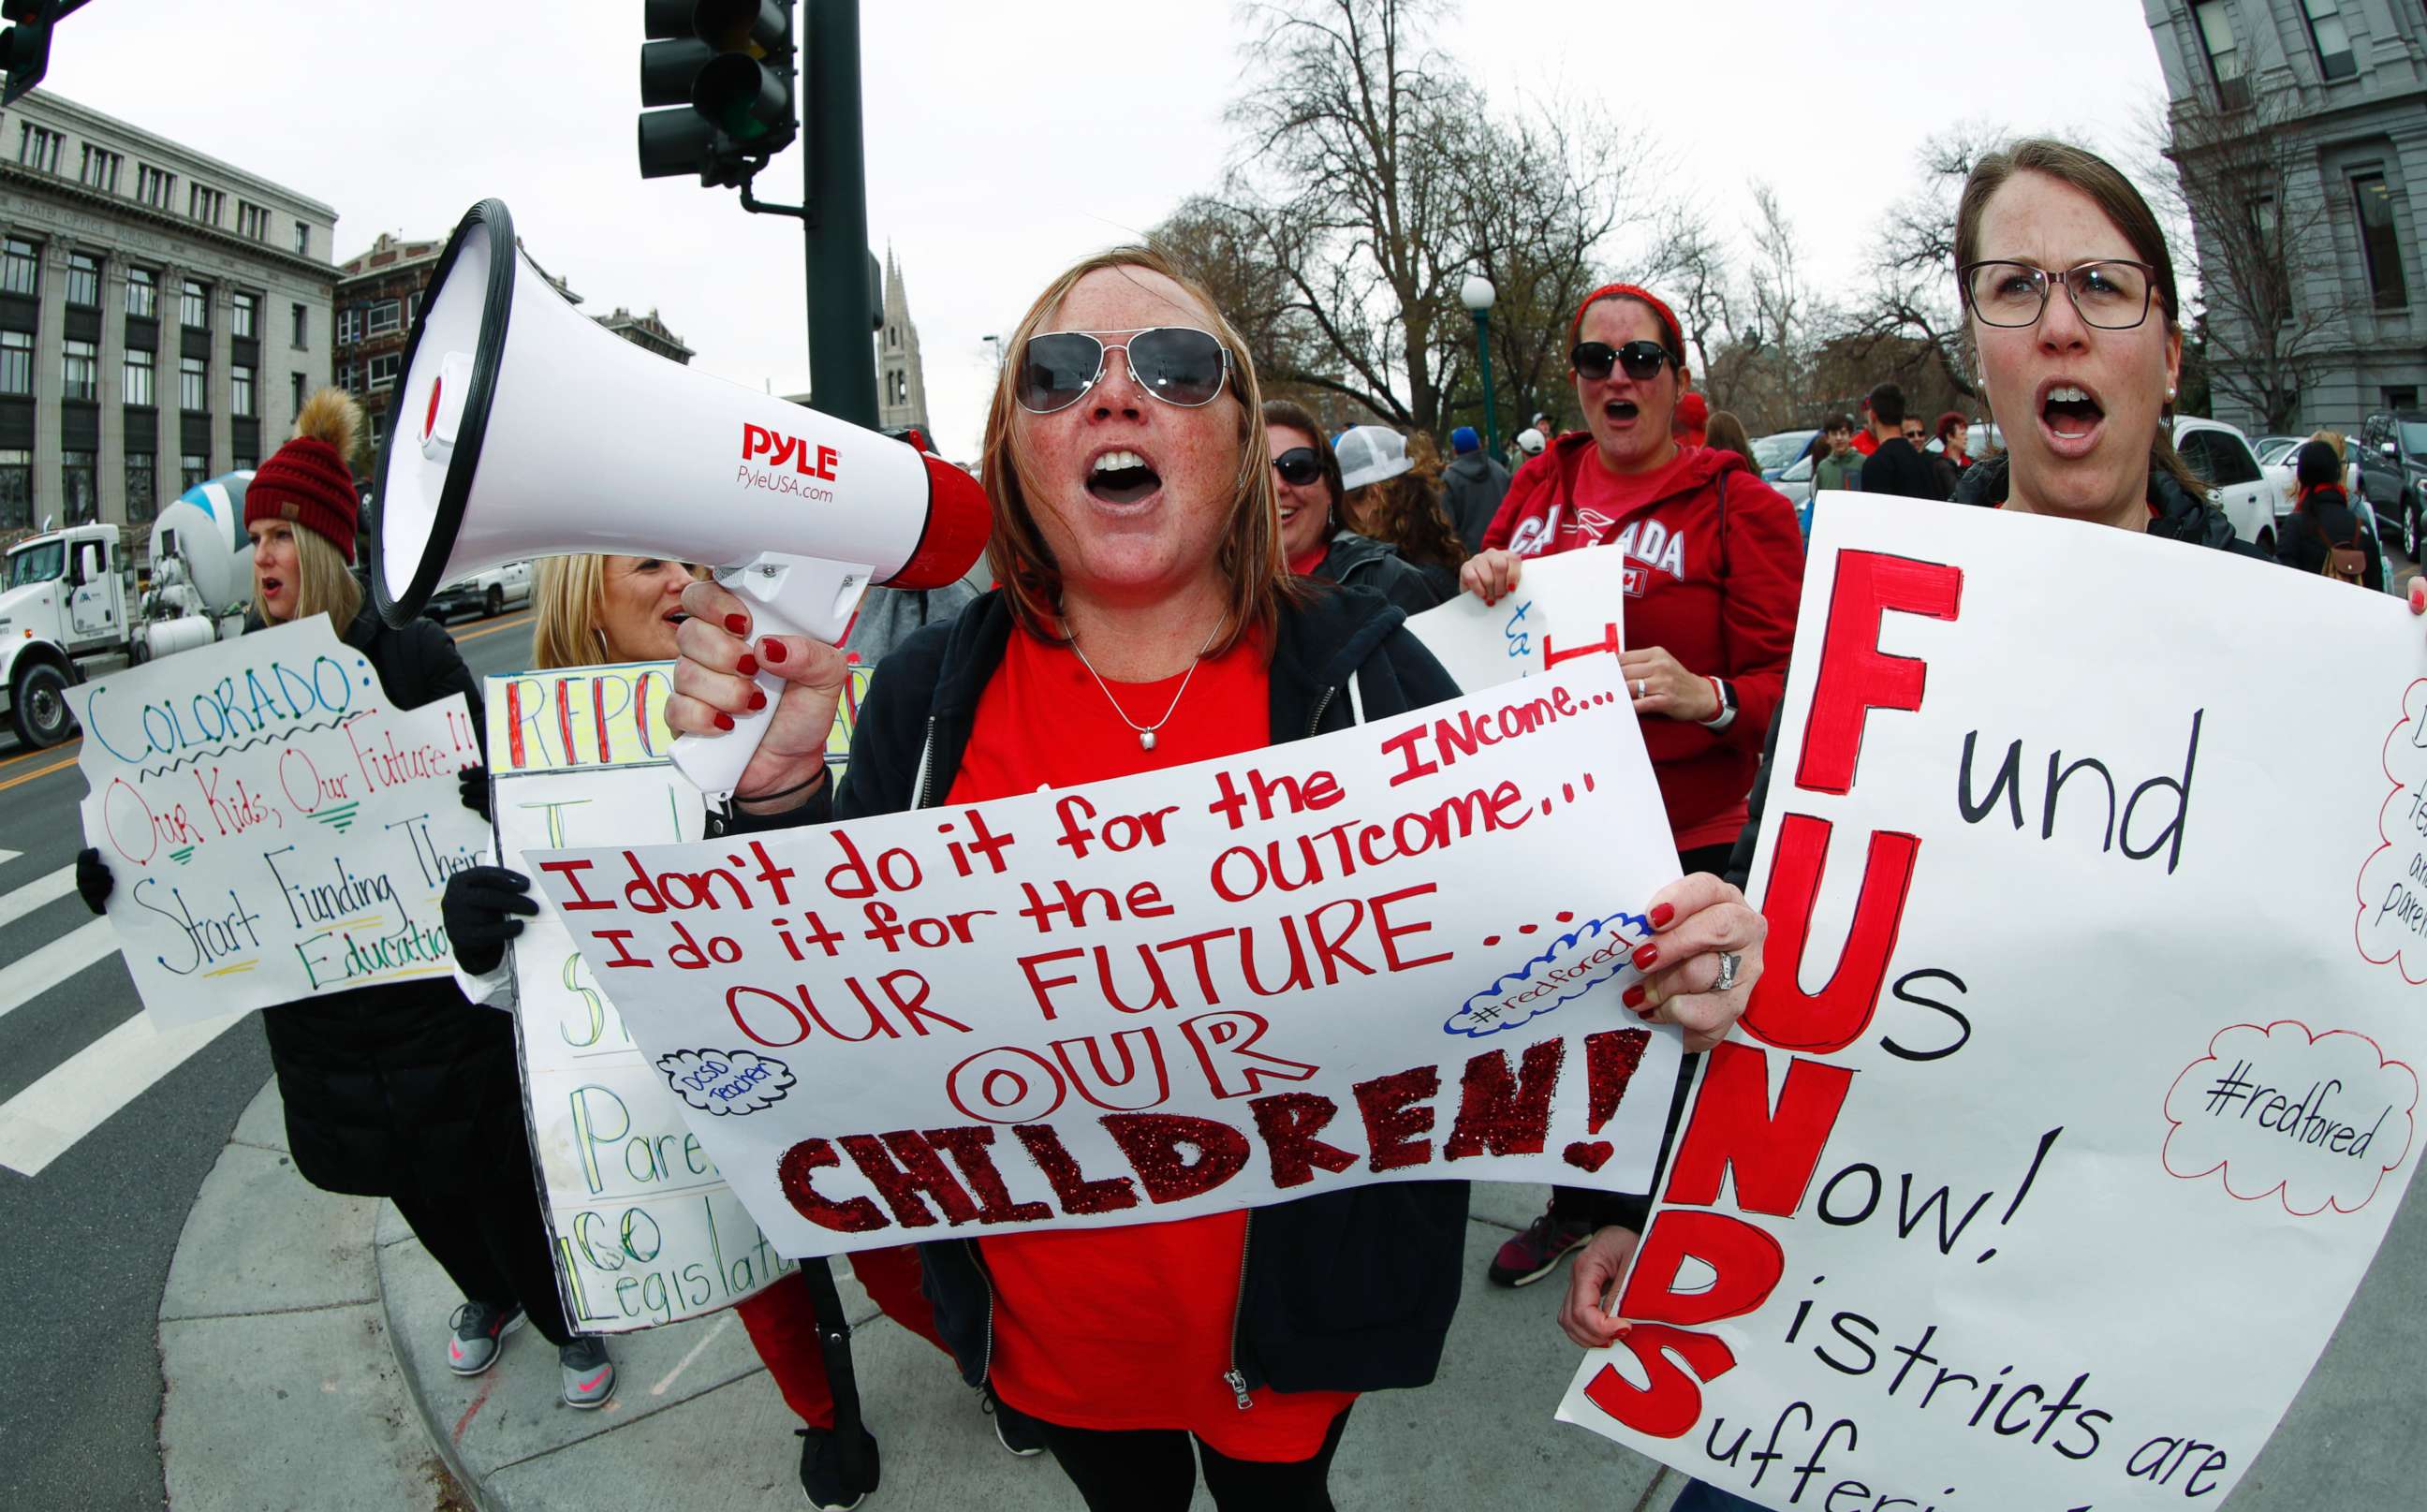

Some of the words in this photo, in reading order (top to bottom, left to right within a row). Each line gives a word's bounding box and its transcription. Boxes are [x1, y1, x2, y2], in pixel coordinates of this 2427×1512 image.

[21, 201, 55, 220] STATE
[64, 211, 106, 234] OFFICE
[736, 465, 833, 503] PyleUSA.com
[742, 422, 839, 482] PYLE
[1508, 504, 1684, 582] CAADA
[88, 656, 370, 764] COLORADO:
[507, 670, 674, 770] REPO
[193, 767, 283, 836] Kids,
[279, 749, 348, 813] Our
[539, 859, 619, 912] I
[623, 840, 796, 914] don't
[825, 829, 923, 899] do
[937, 808, 1016, 878] it
[1057, 794, 1181, 859] for
[1209, 768, 1346, 830] the
[133, 878, 260, 975] Start
[264, 845, 409, 938] Funding
[295, 919, 449, 991] Educatio
[591, 929, 655, 970] I
[667, 919, 743, 970] do
[771, 910, 846, 962] it
[864, 900, 999, 953] for
[1019, 879, 1175, 933] the
[725, 968, 975, 1048] OUR
[1469, 930, 1634, 1023] #redfored
[681, 1060, 729, 1092] DCSD
[946, 1009, 1321, 1124] OUR
[2205, 1059, 2393, 1160] #redfored
[569, 1084, 720, 1195] Pare
[776, 1026, 1653, 1234] CHILDREN!
[559, 1196, 795, 1328] Legislatu
[2125, 1437, 2228, 1498] are
